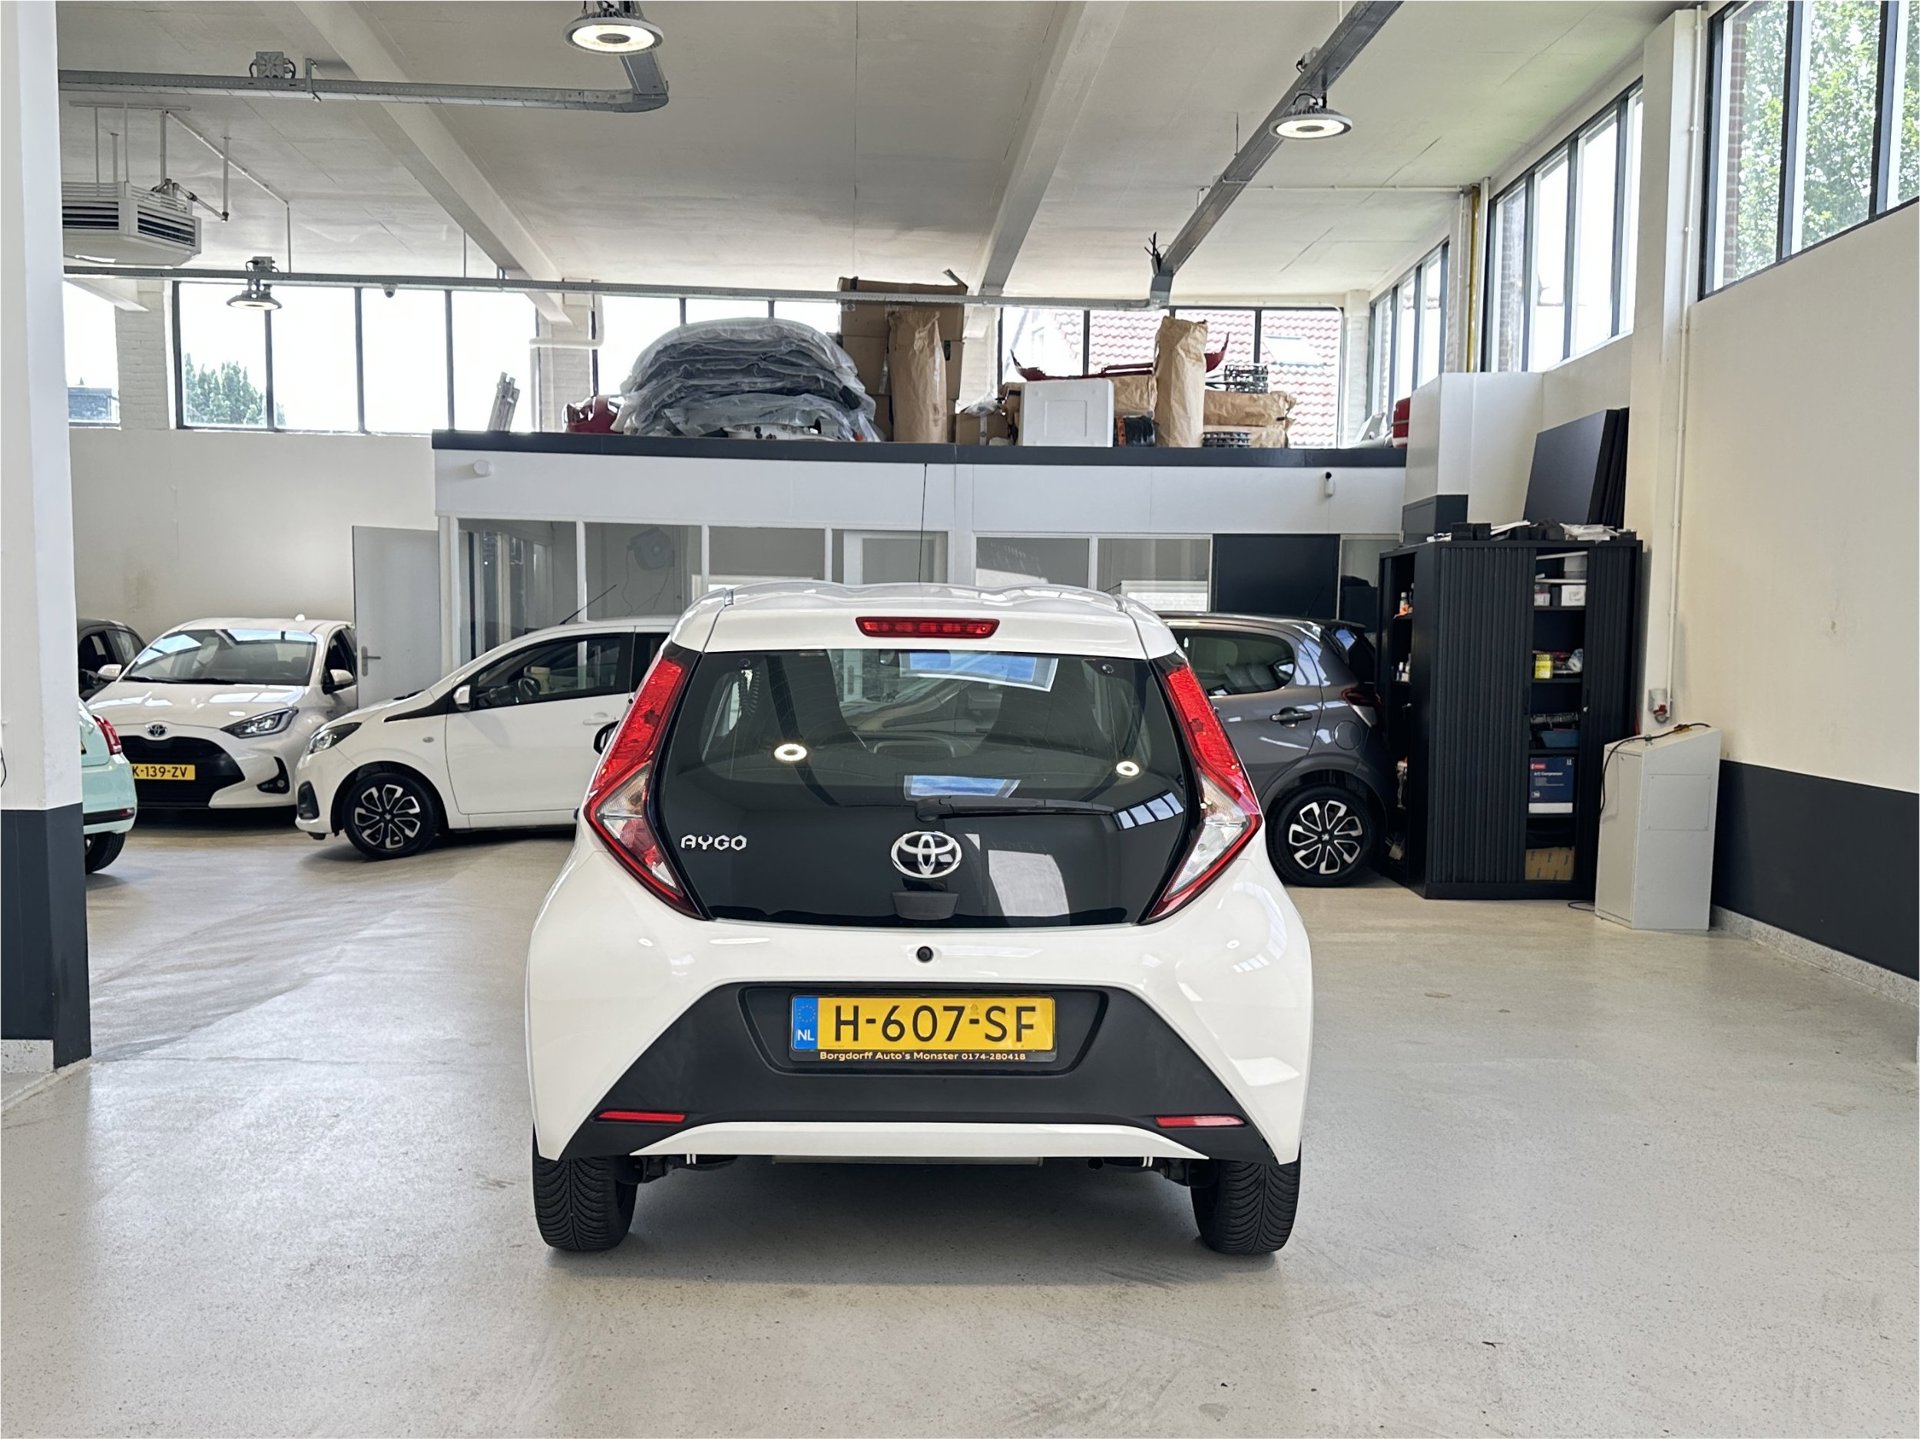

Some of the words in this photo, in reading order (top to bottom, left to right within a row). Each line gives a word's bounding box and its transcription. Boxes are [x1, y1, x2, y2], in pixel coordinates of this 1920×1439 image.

[132, 766, 187, 778] K-139-ZV
[680, 834, 748, 851] AYGO
[834, 1004, 1037, 1043] H-607-SF
[797, 1030, 815, 1042] NL
[819, 1051, 873, 1062] Borgdorff
[875, 1051, 911, 1060] Auto's
[913, 1051, 959, 1061] Monster
[961, 1052, 1026, 1061] 0174-280418
